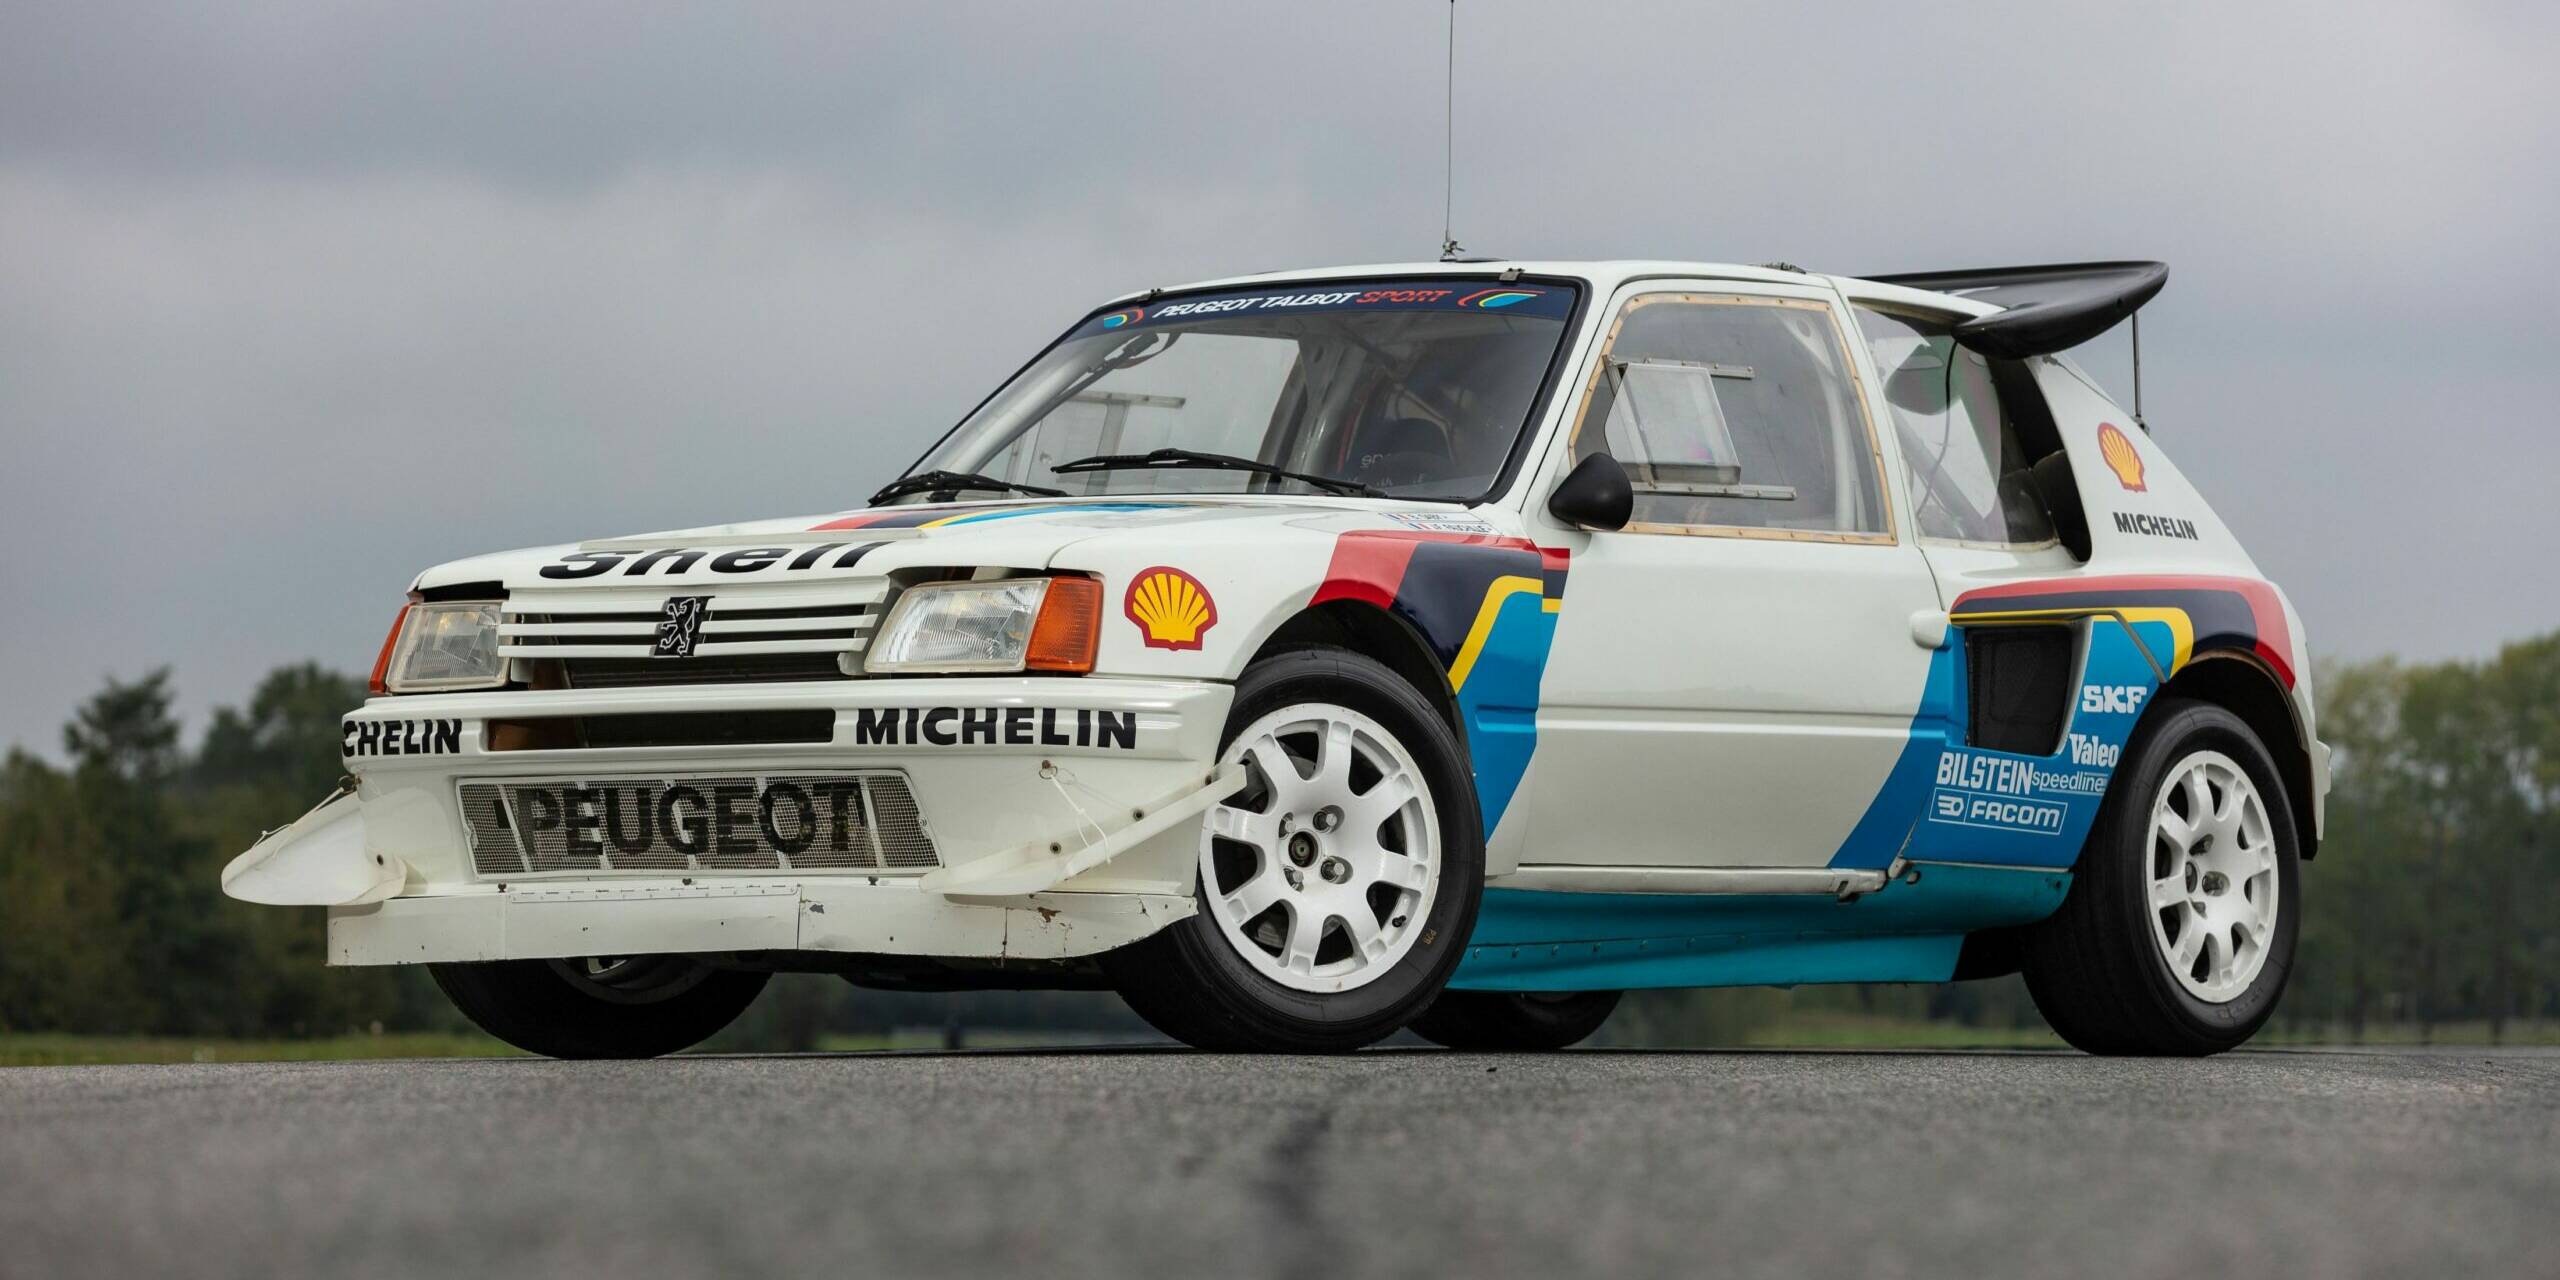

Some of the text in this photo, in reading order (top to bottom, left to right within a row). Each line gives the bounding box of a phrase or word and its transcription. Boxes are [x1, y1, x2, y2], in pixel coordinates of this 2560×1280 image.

[1152, 290, 1452, 318] PEUGEOT TALBOT SPORT
[2112, 511, 2199, 541] MICHELIN
[539, 541, 895, 579] Shell
[2082, 685, 2147, 714] SKF
[856, 706, 1136, 750] MICHELIN
[2069, 733, 2119, 768] Valeo
[1936, 751, 2034, 795] BILSTEIN
[2032, 771, 2106, 794] speedline
[516, 782, 862, 858] PEUGEOT
[1970, 800, 2060, 828] FACOM
